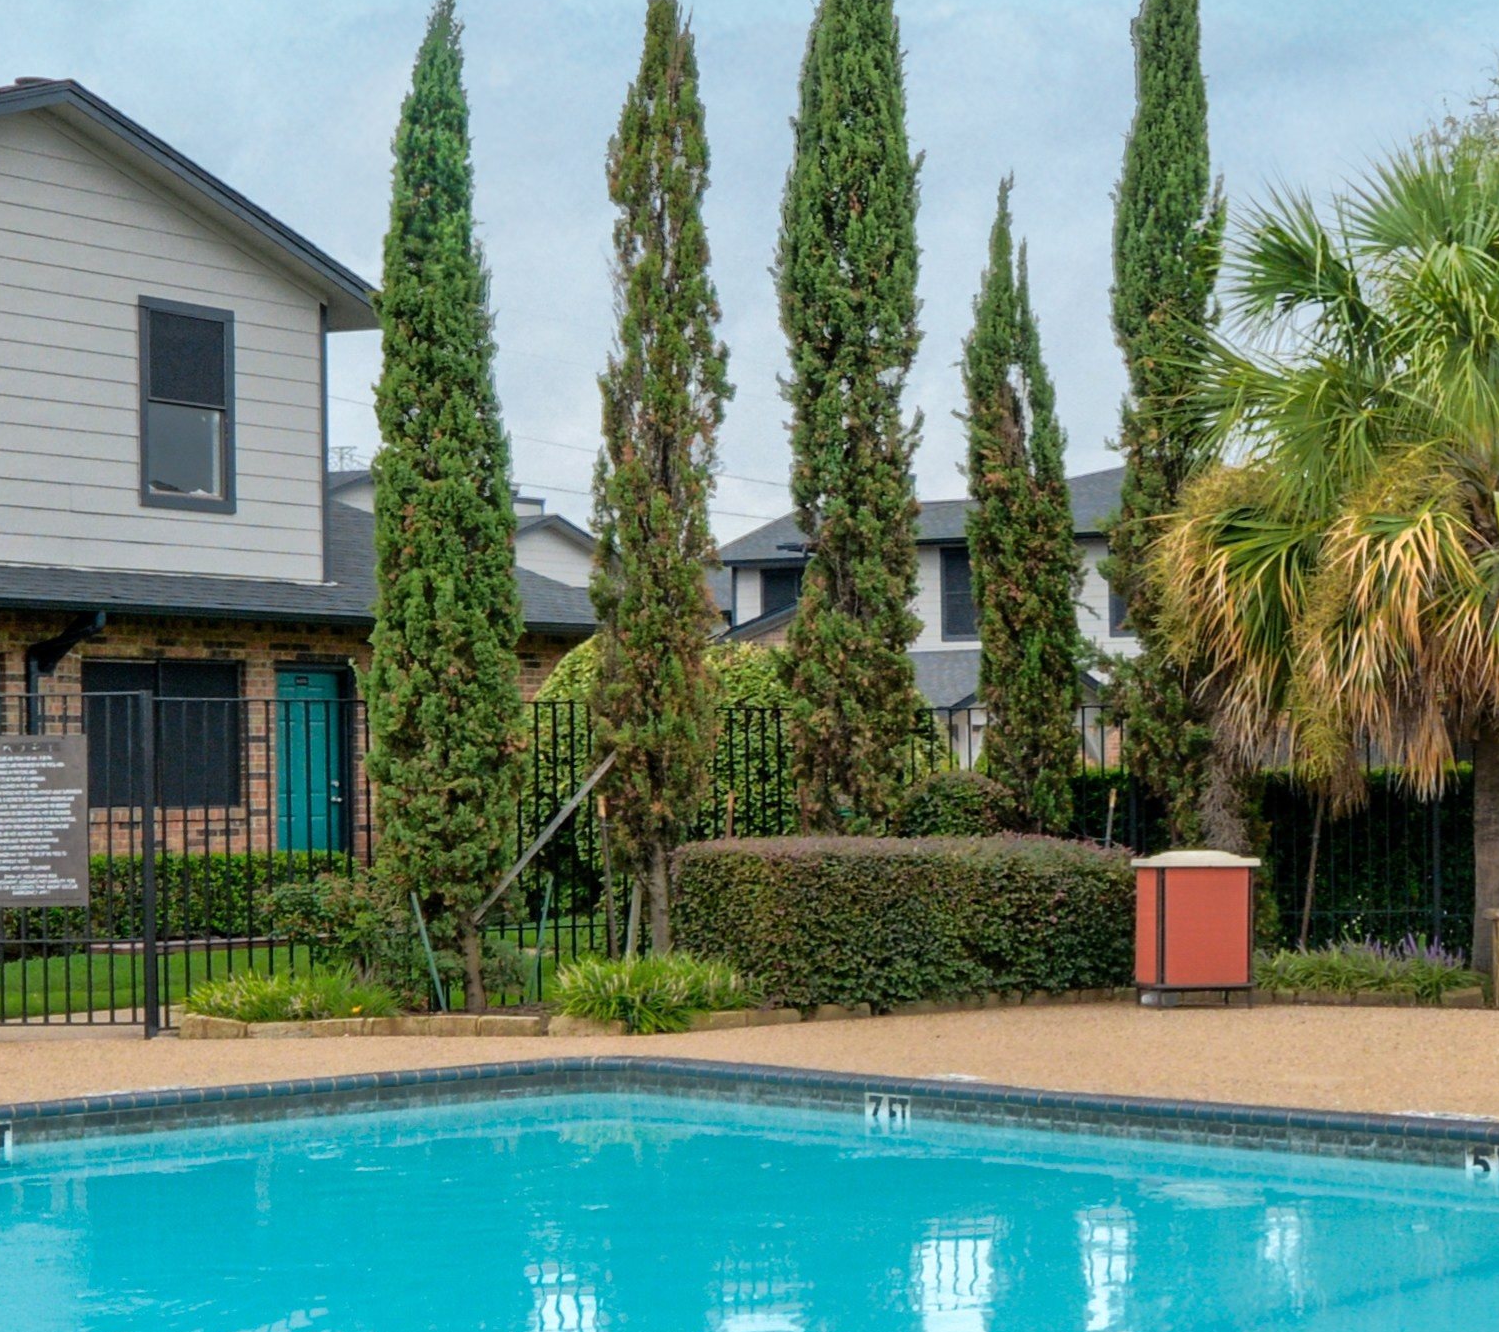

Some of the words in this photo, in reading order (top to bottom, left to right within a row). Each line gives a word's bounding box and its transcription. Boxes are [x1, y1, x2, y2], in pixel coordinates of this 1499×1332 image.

[869, 1095, 883, 1117] 7
[889, 1097, 909, 1119] FT
[1473, 1147, 1494, 1172] 5
